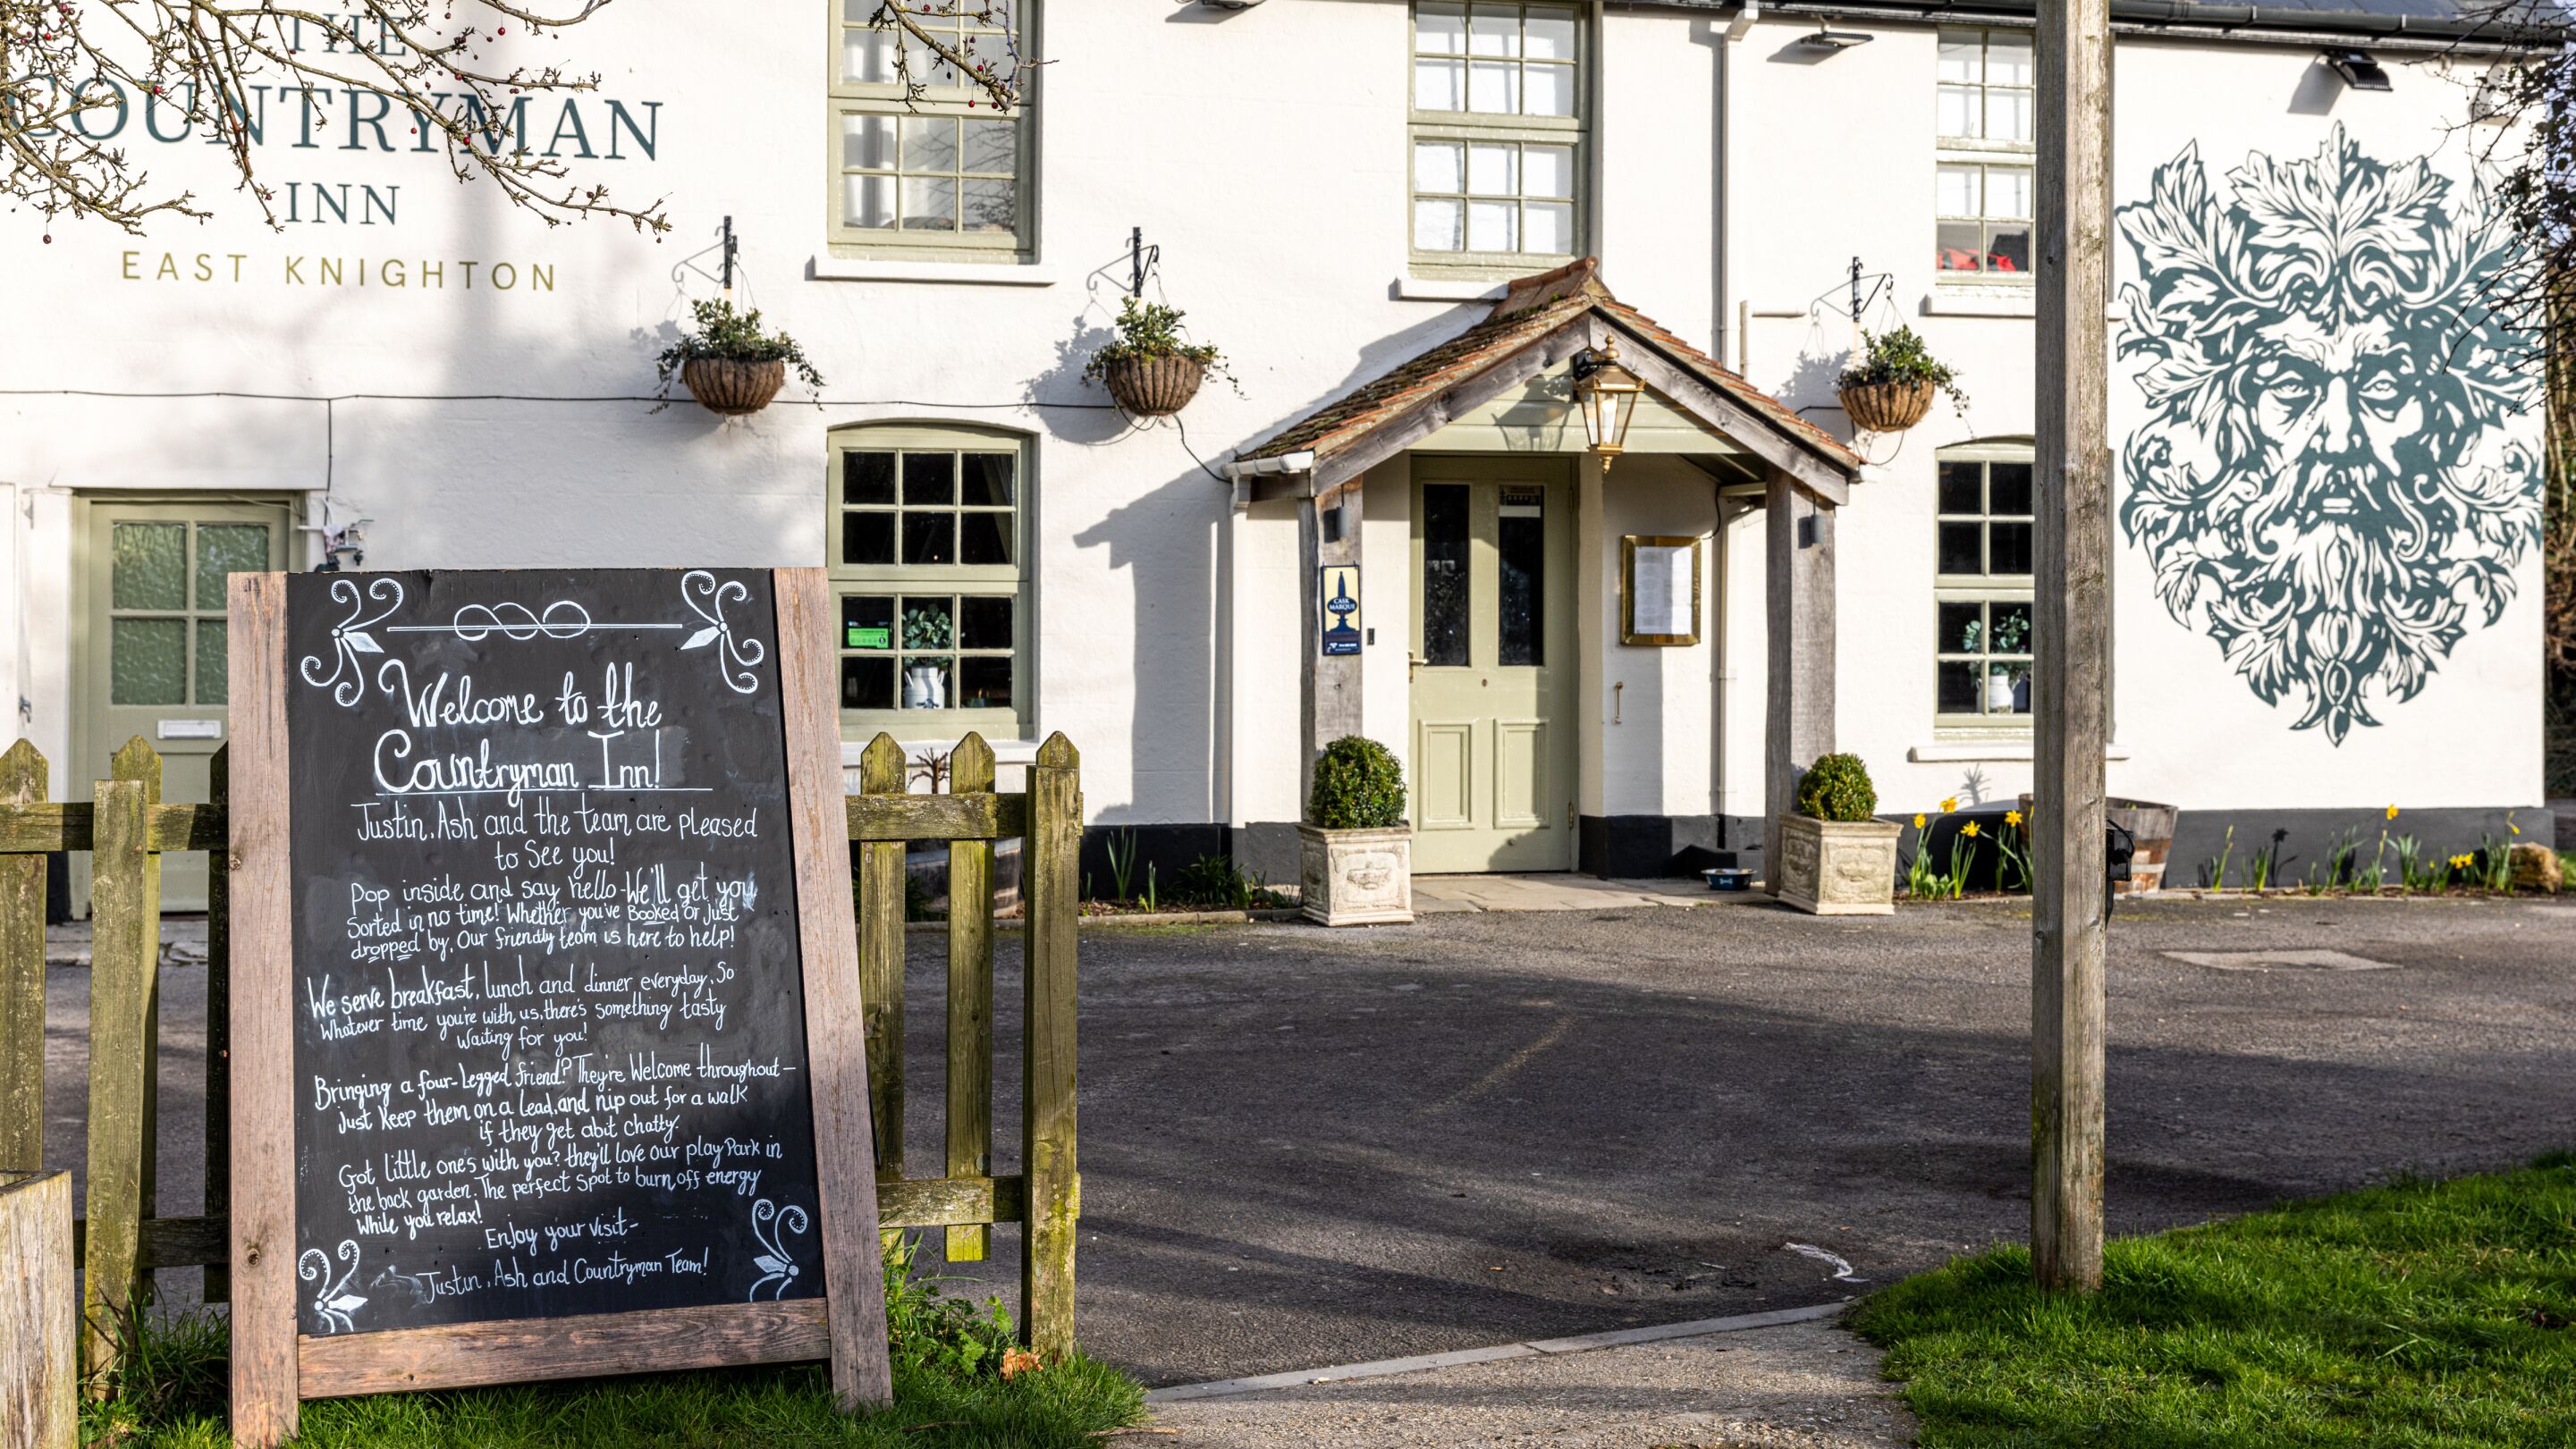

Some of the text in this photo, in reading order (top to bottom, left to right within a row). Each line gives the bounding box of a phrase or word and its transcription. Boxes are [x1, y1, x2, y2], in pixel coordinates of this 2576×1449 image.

[278, 12, 406, 56] THE
[6, 73, 663, 162] COUNTRYMAN
[285, 181, 401, 226] INN
[122, 250, 555, 292] EAST KNIGHTON
[378, 659, 662, 728] Welcome to the
[375, 729, 661, 806] Countryman Inn!
[438, 796, 477, 839] Ash
[485, 798, 528, 836] and
[534, 796, 570, 835] the
[573, 792, 631, 836] team
[636, 813, 671, 831] are
[679, 806, 757, 840] pleased
[494, 841, 518, 871] to
[572, 837, 615, 880] you!
[351, 882, 390, 915] Pop
[402, 873, 464, 903] inside
[470, 876, 513, 904] and
[521, 880, 561, 911] say
[677, 862, 709, 908] get
[715, 876, 758, 911] you
[408, 906, 425, 932] in
[427, 910, 451, 927] no
[455, 902, 500, 925] time!
[579, 903, 621, 932] you've
[351, 931, 420, 964] dropped
[495, 926, 555, 955] friendly
[559, 925, 597, 949] team
[604, 931, 621, 944] is
[627, 922, 661, 948] here
[665, 925, 685, 948] to
[689, 924, 735, 948] help!
[307, 974, 336, 1018] We
[341, 986, 384, 1015] serve
[484, 954, 534, 998] lunch
[539, 963, 575, 994] and
[585, 962, 633, 993] dinner
[391, 1011, 428, 1032] time
[436, 1006, 477, 1041] you're
[483, 1002, 516, 1028] with
[543, 998, 587, 1021] there's
[595, 991, 673, 1030] something
[680, 988, 727, 1031] tasty
[519, 1025, 544, 1049] for
[553, 1022, 587, 1057] you!
[315, 1074, 392, 1110] Bringing
[401, 1080, 414, 1094] a
[515, 1057, 571, 1088] friend?
[572, 1053, 626, 1092] They're
[424, 1098, 471, 1126] them
[474, 1101, 497, 1119] on
[498, 1100, 515, 1116] a
[558, 1087, 589, 1116] and
[595, 1088, 625, 1115] nip
[629, 1084, 659, 1106] out
[664, 1085, 687, 1110] for
[690, 1092, 704, 1106] a
[479, 1119, 494, 1147] if
[498, 1118, 543, 1155] they
[546, 1117, 575, 1150] get
[339, 1159, 376, 1194] Got
[384, 1149, 431, 1183] little
[482, 1148, 519, 1172] with
[524, 1150, 561, 1182] you?
[615, 1141, 646, 1164] love
[765, 1134, 783, 1159] in
[348, 1194, 376, 1215] the
[376, 1186, 412, 1211] back
[417, 1180, 477, 1216] garden.
[474, 1172, 507, 1200] The
[511, 1170, 570, 1200] perfect
[615, 1168, 630, 1184] to
[705, 1169, 762, 1196] energy
[404, 1213, 435, 1241] you
[436, 1200, 484, 1226] relax!
[545, 1223, 586, 1251] your
[494, 1256, 528, 1288] Ash
[533, 1259, 570, 1285] and
[573, 1251, 663, 1285] Countryman
[665, 1246, 709, 1276] Team!
